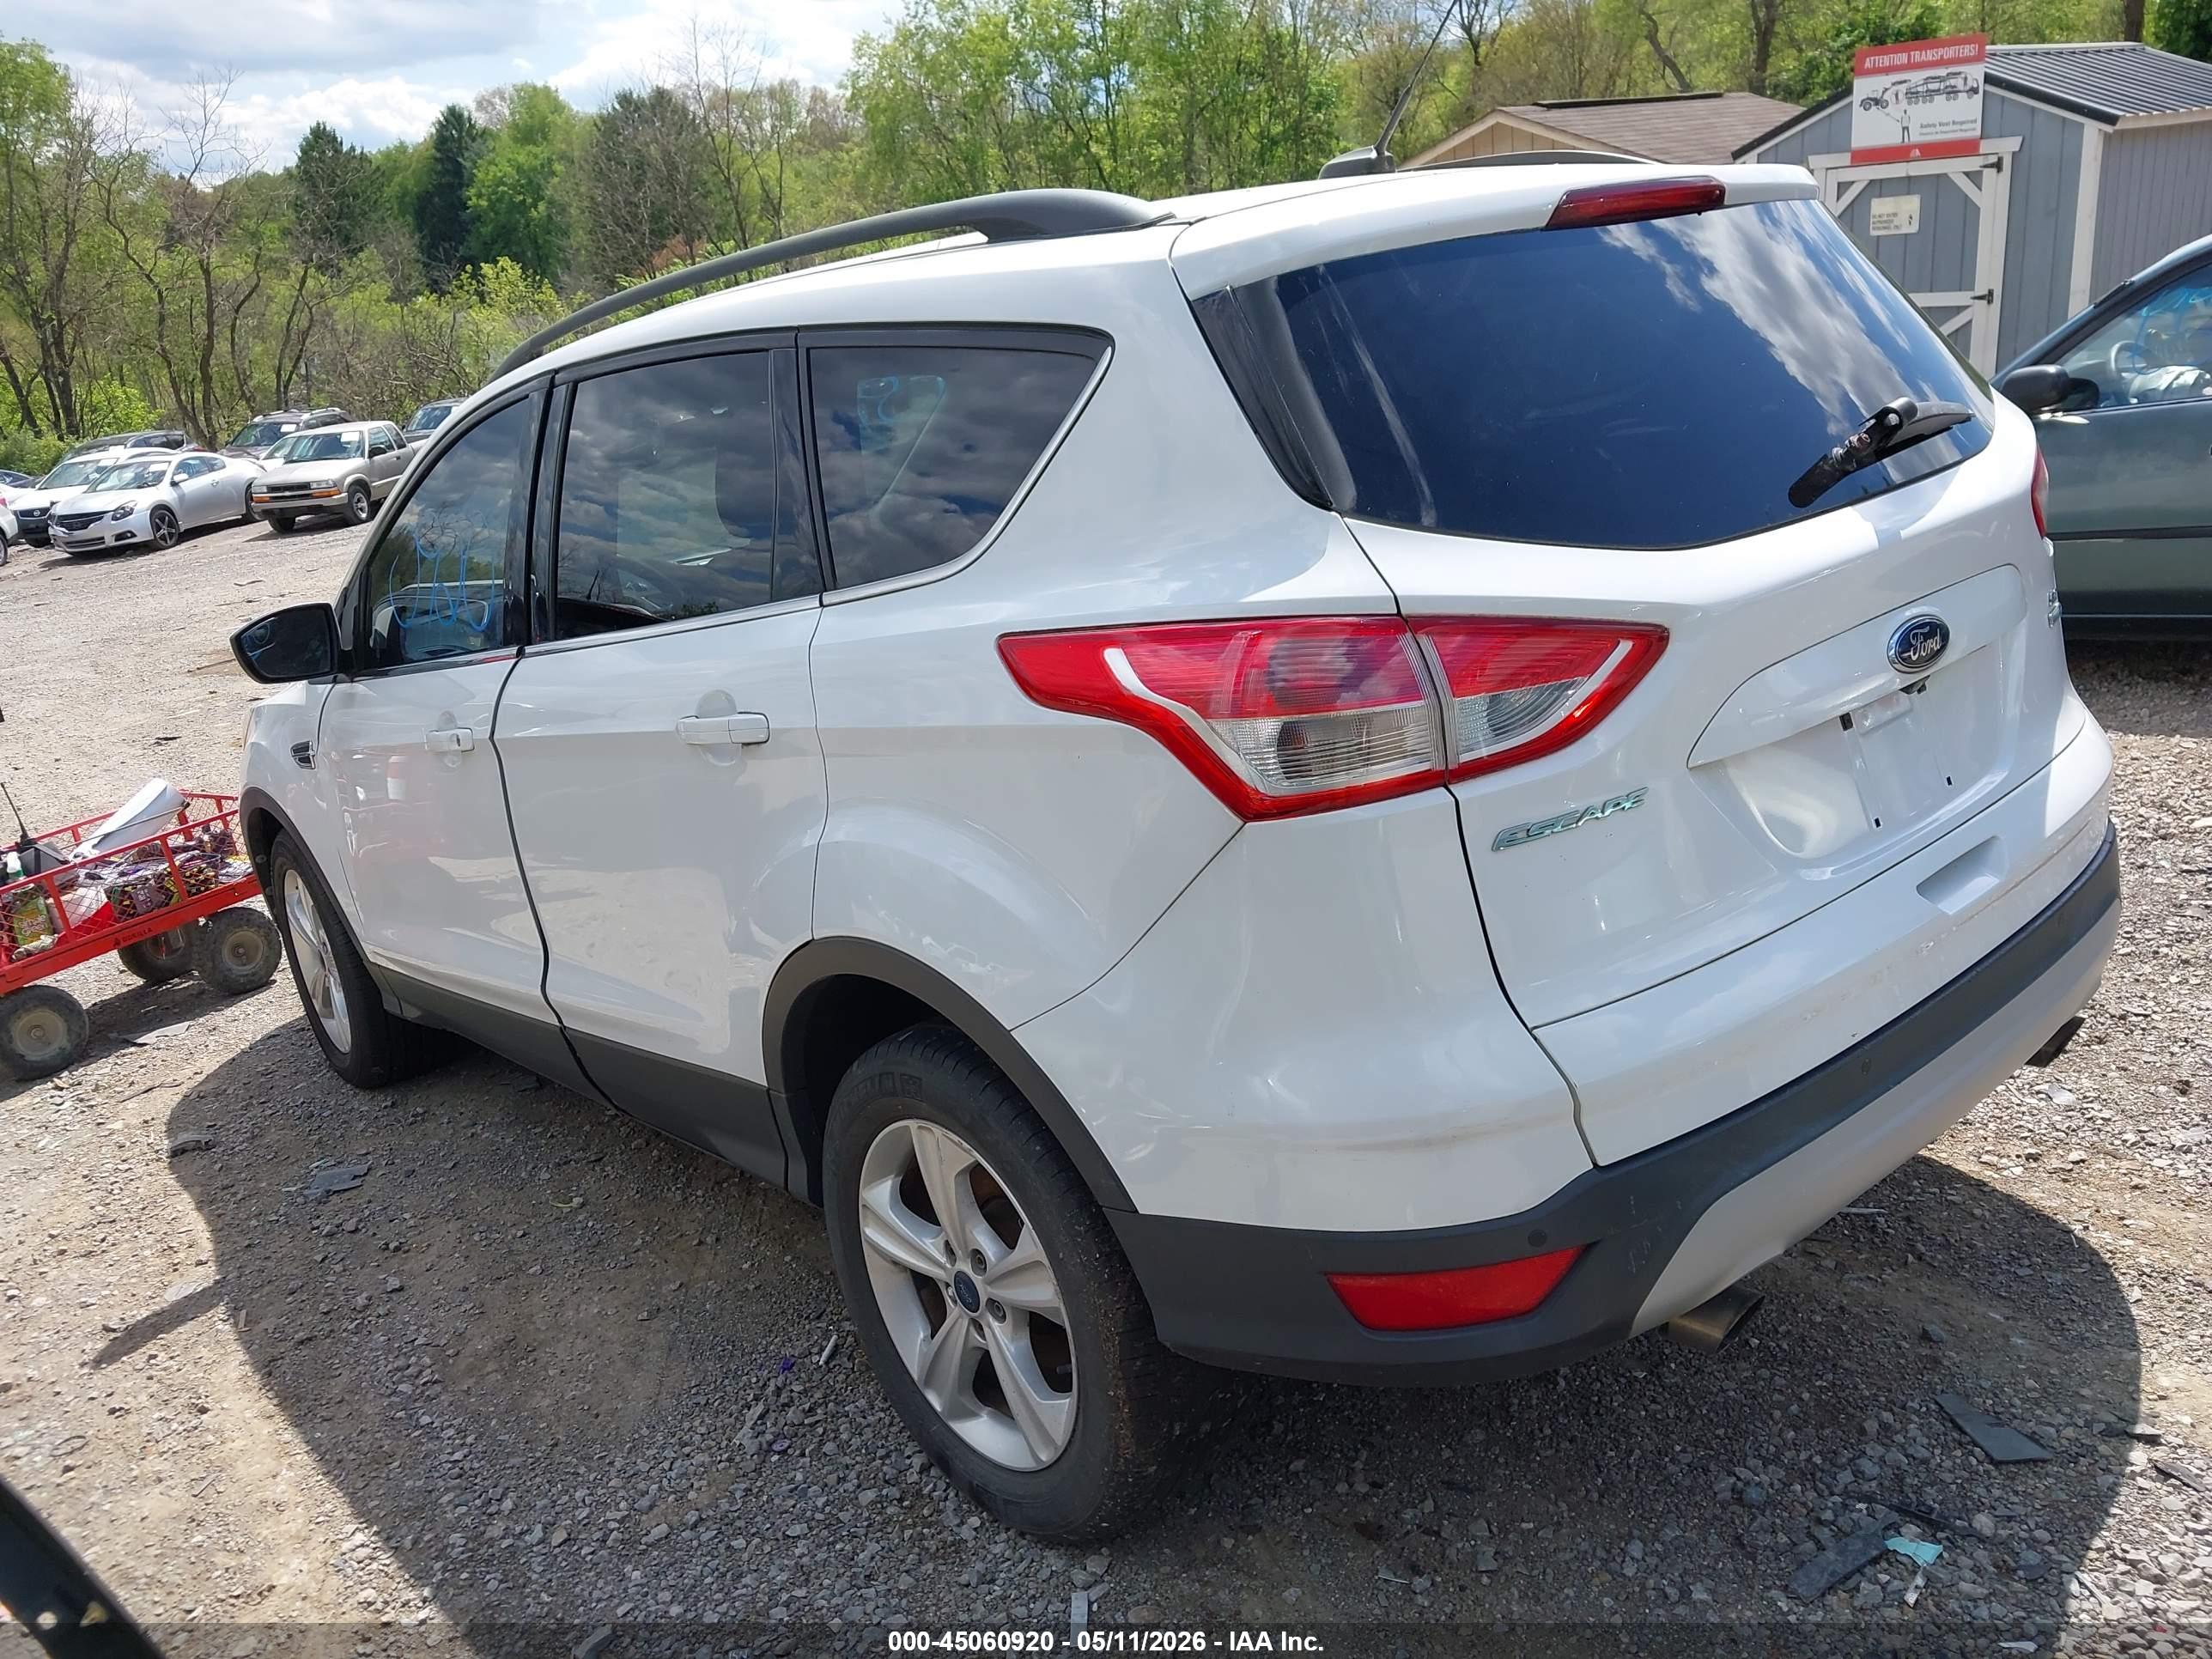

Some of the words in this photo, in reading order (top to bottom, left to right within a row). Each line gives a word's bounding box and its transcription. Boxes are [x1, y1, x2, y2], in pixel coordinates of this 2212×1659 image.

[1864, 52, 1908, 69] ATTENTION
[1910, 44, 1979, 63] TRANSPORTERS!
[1900, 625, 1942, 661] Ford
[1491, 786, 1650, 853] ESCAPE
